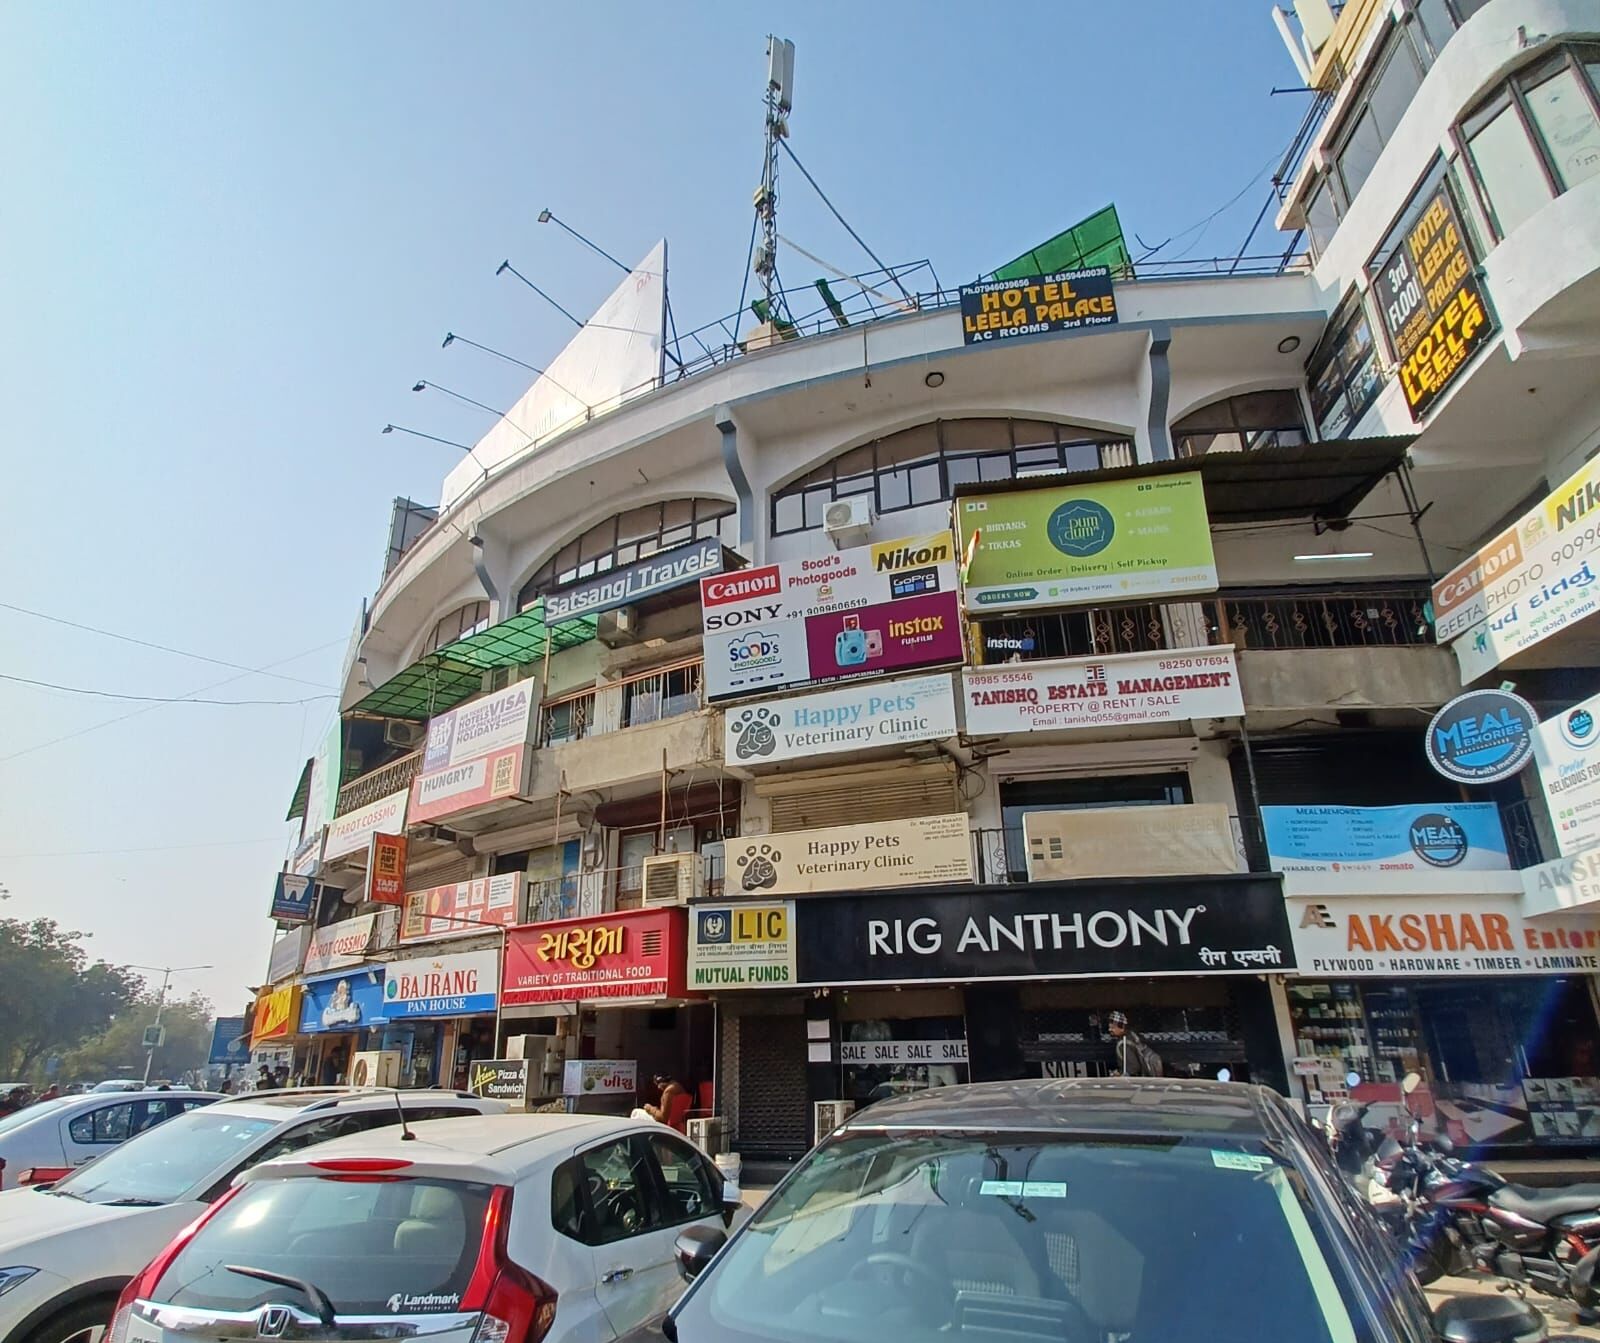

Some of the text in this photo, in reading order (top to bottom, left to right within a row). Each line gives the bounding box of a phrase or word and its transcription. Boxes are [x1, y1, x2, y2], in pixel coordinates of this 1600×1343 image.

[1408, 198, 1449, 262] HOTEL
[1418, 223, 1458, 286] LEELA
[1388, 254, 1409, 293] 3rd
[1427, 250, 1467, 312] PALACE
[982, 282, 1076, 312] HOTEL
[965, 296, 1114, 332] LEELA PALACE
[973, 331, 992, 341] AC
[1000, 323, 1049, 337] ROOMS
[1086, 316, 1112, 324] Floor
[1401, 288, 1475, 386] HOTEL
[1407, 303, 1483, 405] LEELA
[988, 539, 1022, 550] TIKKAS
[801, 555, 841, 571] Sood's
[877, 544, 947, 572] Nikon
[1036, 567, 1062, 576] Order
[1071, 562, 1108, 573] Delivery
[1117, 559, 1134, 568] Self
[1137, 557, 1168, 567] Pickup
[547, 546, 718, 616] Satsangi Travels
[708, 574, 776, 600] Canon
[788, 566, 857, 587] Photogoods
[893, 573, 935, 586] GoPro
[1439, 543, 1517, 606] Canon
[786, 610, 802, 618] +91
[1437, 604, 1483, 639] GEETA
[1486, 563, 1543, 610] PHOTO
[706, 604, 783, 630] SONY
[889, 615, 943, 637] instax
[987, 637, 1022, 649] instax
[968, 657, 1229, 685] 98985 55546 98250 07694
[971, 672, 1231, 706] TANISHQ ESTATE MANAGEMENT
[490, 691, 526, 718] VISA
[794, 696, 915, 727] Happy Pets
[1019, 703, 1084, 715] PROPERTY
[1103, 698, 1136, 710] RENT
[1147, 695, 1180, 706] SALE
[785, 725, 874, 748] Veterinary
[879, 716, 928, 735] Clinic
[1032, 717, 1057, 726] Email
[424, 766, 473, 792] HUNGRY?
[336, 804, 397, 838] TAROT COSSMO
[808, 835, 900, 855] Happy Pets
[797, 854, 914, 875] Veterinary Clinic
[738, 912, 782, 940] LIC
[867, 907, 1197, 955] RIG ANTHONY
[1348, 914, 1514, 952] AKSHAR
[333, 933, 367, 954] COSSMO
[536, 926, 626, 969] સાસુમા
[518, 966, 651, 985] VARIETY OF TRADITIONAL FOOD
[695, 966, 788, 984] MUTUAL FUNDS
[1314, 956, 1598, 971] PLYWOOD HARDWARE TIMBER LAMINATE
[400, 969, 477, 999] BAJRANG
[407, 998, 466, 1012] PAN HOUSE
[842, 1044, 967, 1059] SALE SALE SALE SALE
[497, 1070, 517, 1079] Pizza
[488, 1083, 524, 1093] Sandwich
[404, 1293, 459, 1305] Landmark
